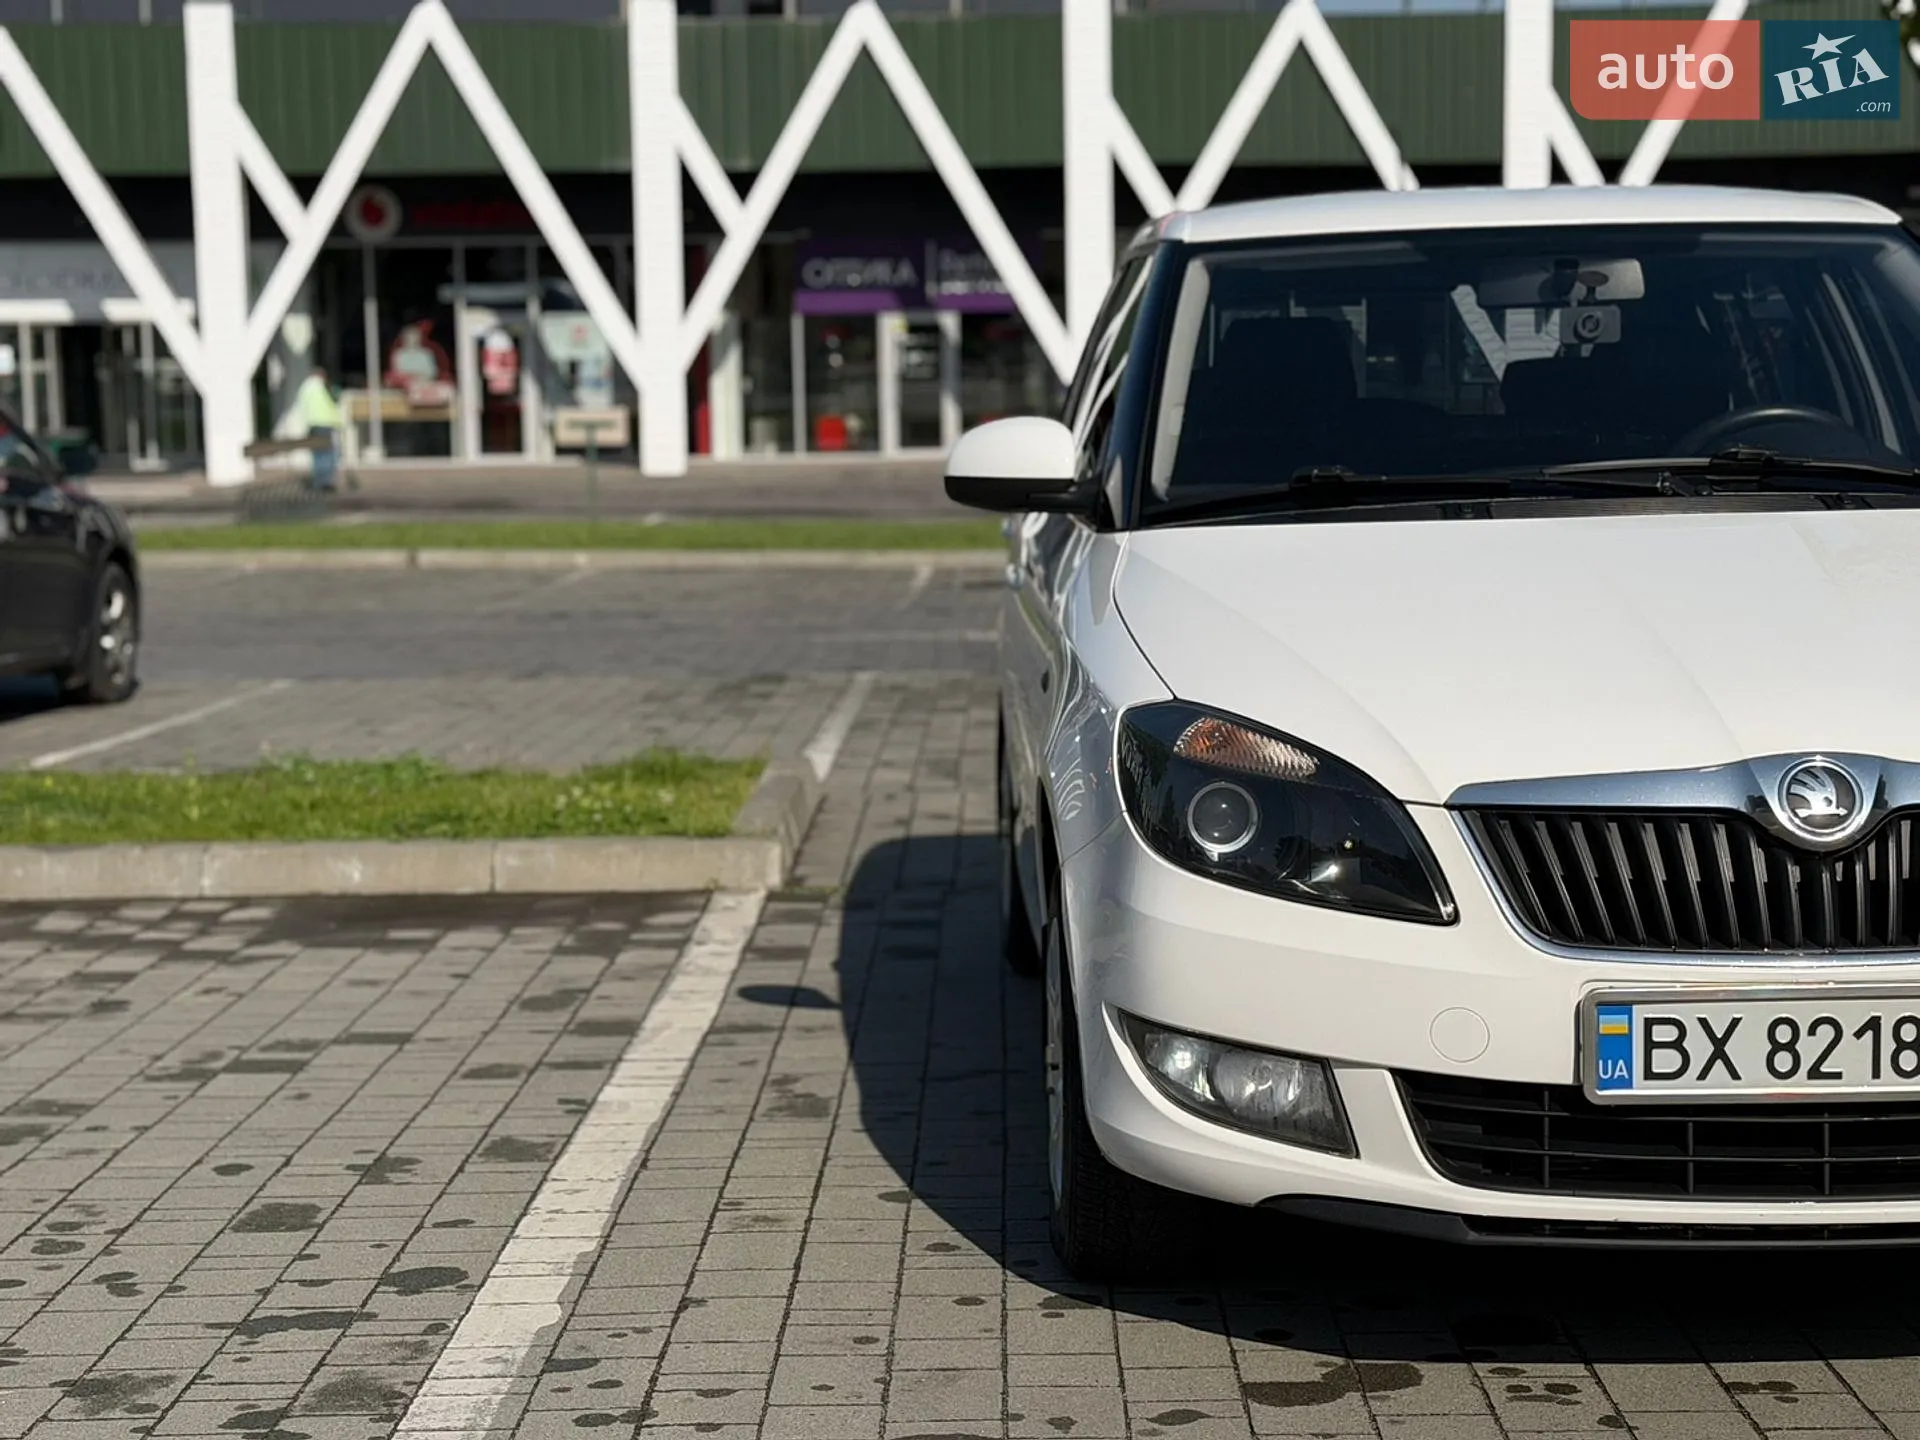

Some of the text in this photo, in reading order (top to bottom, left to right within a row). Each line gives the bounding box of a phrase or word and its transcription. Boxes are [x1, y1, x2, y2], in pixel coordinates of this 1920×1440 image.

[1598, 1059, 1629, 1080] UA
[1643, 1015, 1920, 1081] BX 8218
